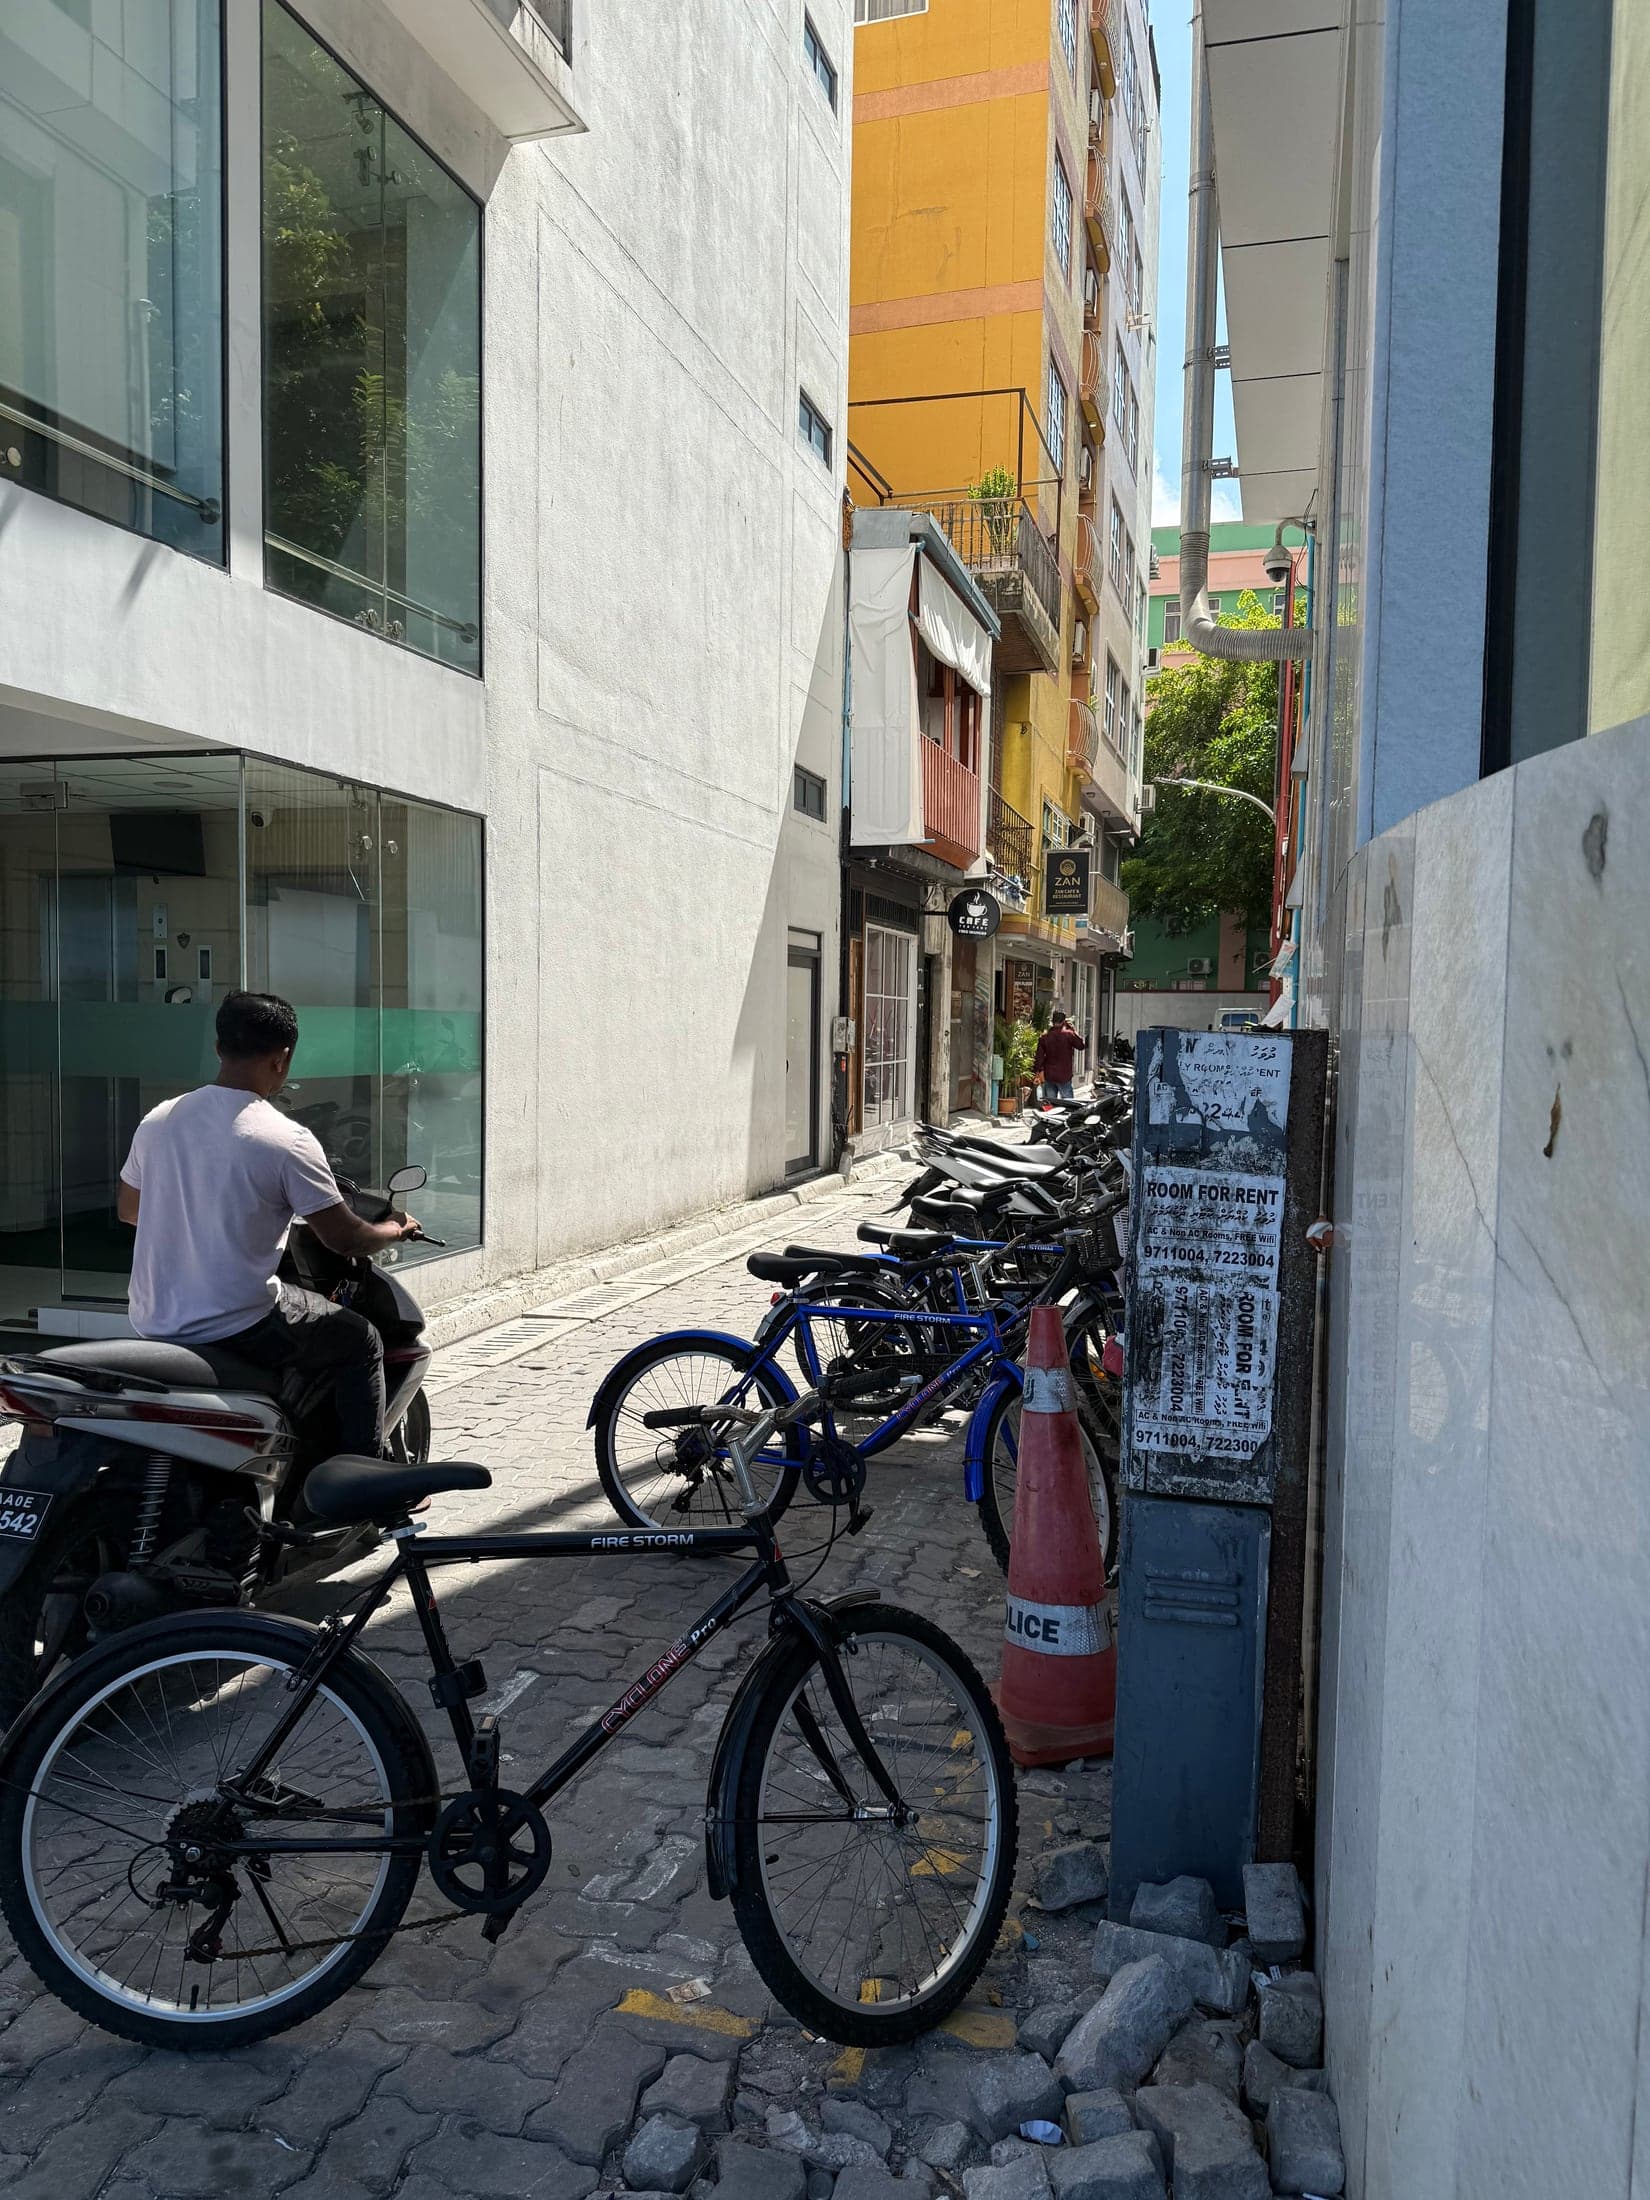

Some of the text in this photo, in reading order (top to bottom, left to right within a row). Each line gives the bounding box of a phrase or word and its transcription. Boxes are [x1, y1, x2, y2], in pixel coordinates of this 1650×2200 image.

[1054, 876, 1080, 886] ZAN
[1257, 1067, 1280, 1078] ENT
[1147, 1181, 1279, 1205] ROOM FOR RENT
[1147, 1226, 1158, 1235] AC
[1169, 1228, 1186, 1237] Non
[1188, 1230, 1200, 1238] AC
[1203, 1231, 1233, 1241] Rooms,
[1235, 1233, 1257, 1242] FREE
[1259, 1234, 1275, 1243] Wifi
[1144, 1245, 1274, 1268] 9711004, 7223004
[893, 1313, 951, 1325] FIRE STORM
[1237, 1291, 1255, 1338] ROOM
[1236, 1342, 1253, 1374] FOR
[1170, 1353, 1185, 1412] 7223004
[1138, 1411, 1150, 1420] AC
[1136, 1430, 1201, 1451] 9711004,
[591, 1533, 694, 1548] FIRE STORM
[1006, 1604, 1060, 1645] LICE
[600, 1617, 717, 1735] CYCLONE Pro
